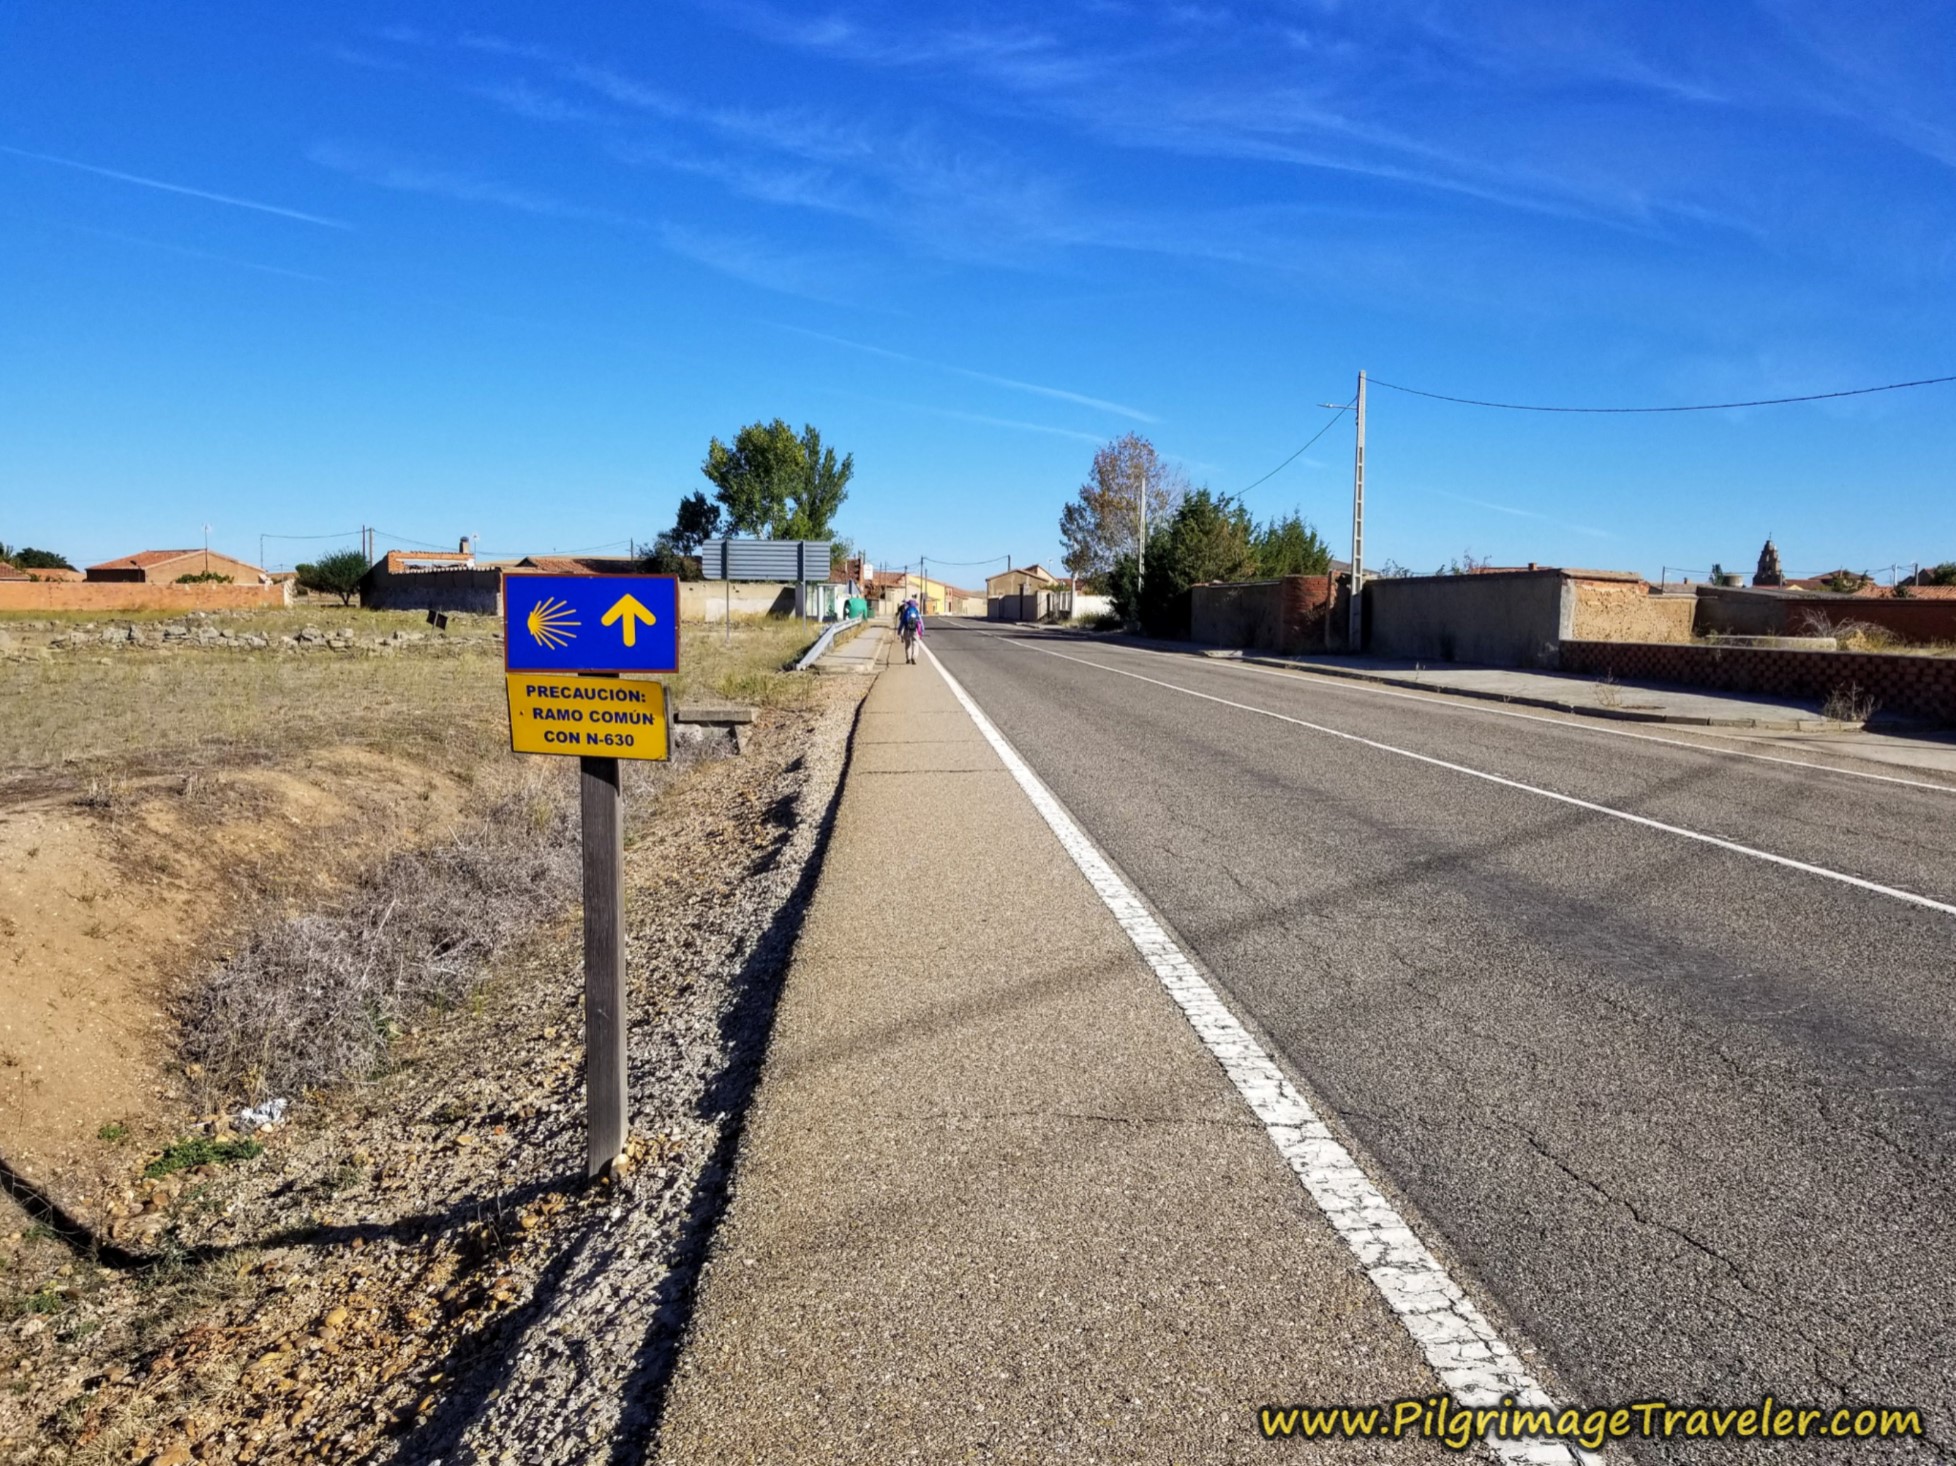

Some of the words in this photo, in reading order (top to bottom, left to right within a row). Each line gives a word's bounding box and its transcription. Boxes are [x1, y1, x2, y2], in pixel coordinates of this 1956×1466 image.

[526, 685, 646, 703] PRECAUCIÓN:
[533, 707, 583, 722] RAMO
[589, 709, 654, 725] COMÚN
[544, 730, 580, 744] CON
[586, 733, 634, 747] N-630
